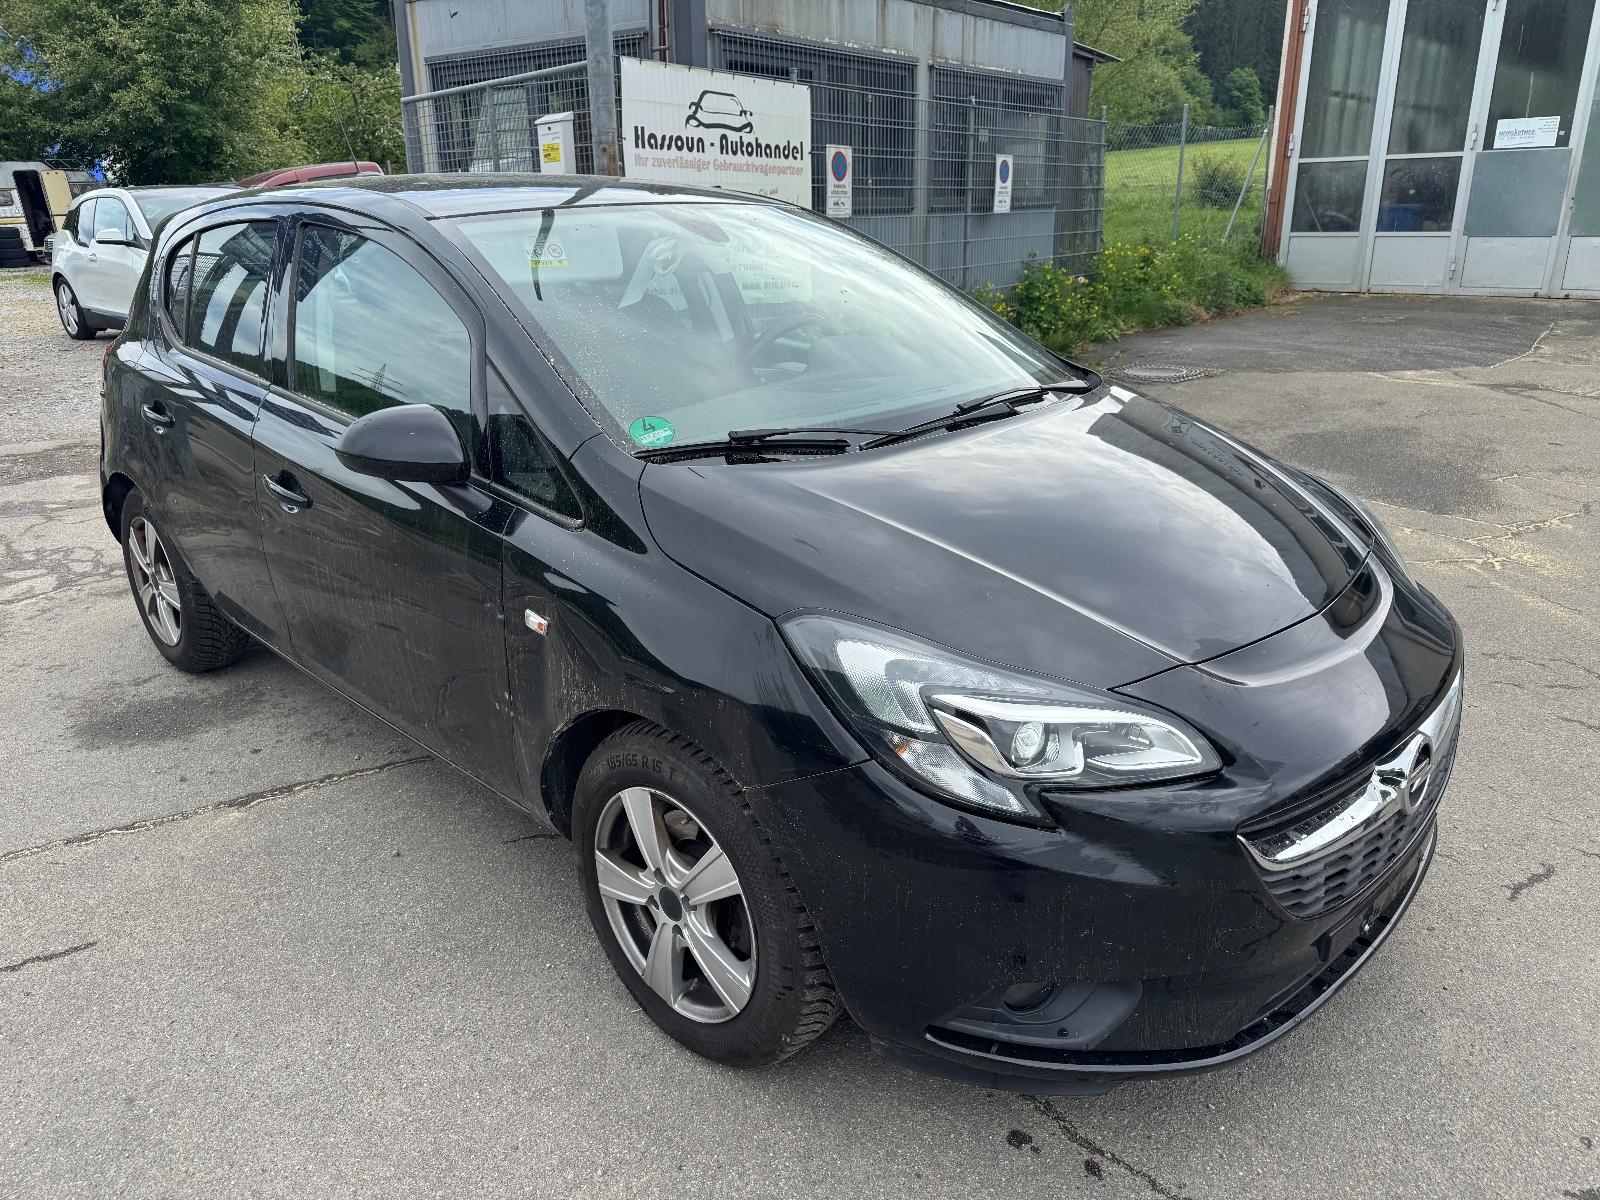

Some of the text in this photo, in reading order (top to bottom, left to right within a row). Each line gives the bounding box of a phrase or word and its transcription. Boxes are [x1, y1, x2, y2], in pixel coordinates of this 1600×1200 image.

[634, 126, 705, 153] Hassoun
[719, 134, 804, 160] Autohandel
[634, 154, 804, 177] Ihr zuverlässiger Gebrauchtwagenpartner
[641, 418, 656, 431] 4
[607, 753, 638, 770] 185/65
[641, 755, 650, 769] R
[652, 758, 663, 774] 15
